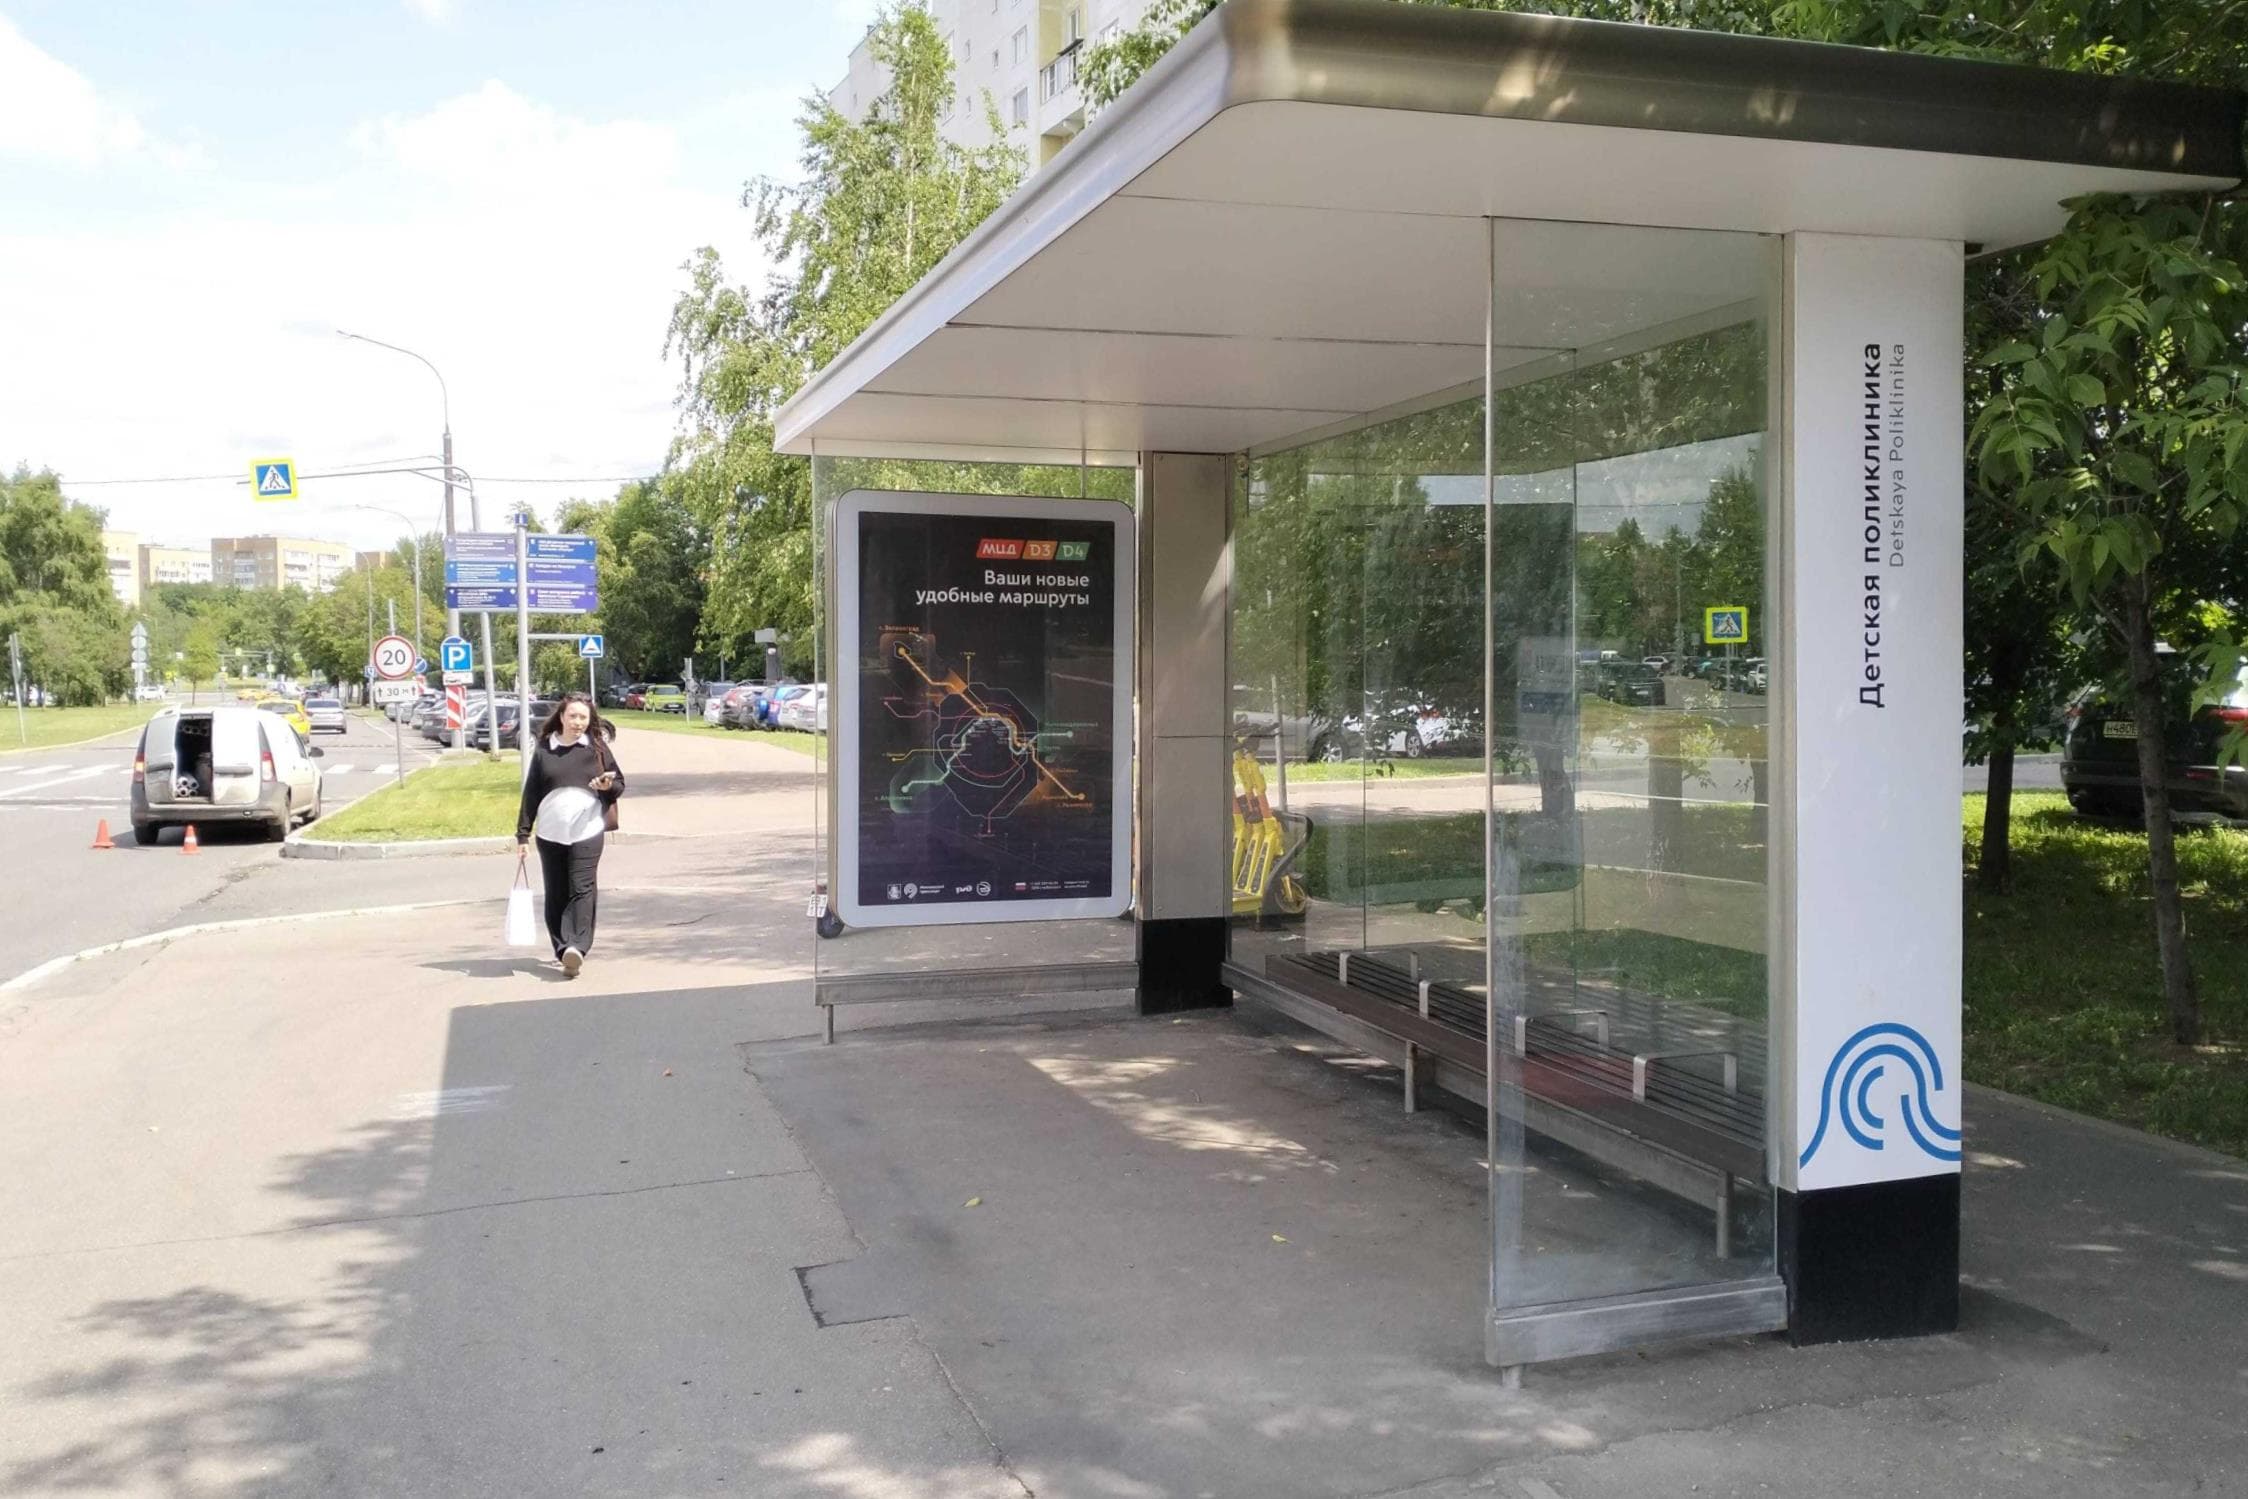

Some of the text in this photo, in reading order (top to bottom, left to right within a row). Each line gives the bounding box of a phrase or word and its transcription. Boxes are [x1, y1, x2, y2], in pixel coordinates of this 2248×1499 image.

[1888, 344, 1908, 568] Detskaya Poliklinika
[1859, 343, 1885, 708] Детская поликлиника
[981, 543, 1085, 558] МЦД D3 D4
[984, 569, 1090, 587] Ваши новые
[915, 586, 1090, 608] удобные маршруты
[382, 649, 406, 666] 20
[447, 646, 467, 670] P
[386, 687, 400, 697] 30
